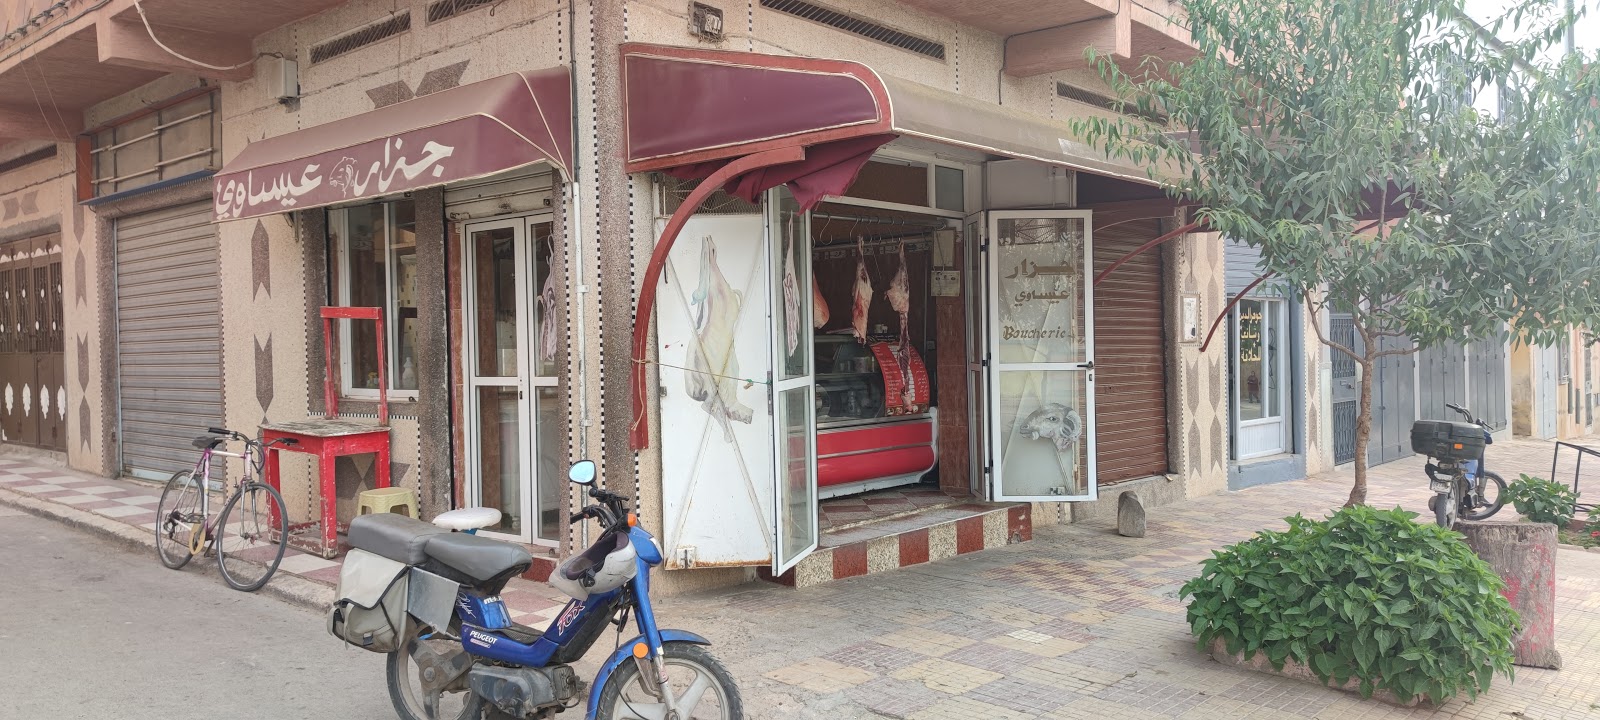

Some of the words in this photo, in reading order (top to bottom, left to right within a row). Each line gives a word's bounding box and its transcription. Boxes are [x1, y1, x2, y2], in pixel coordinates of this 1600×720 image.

[353, 137, 455, 197] جزار
[215, 163, 323, 220] عيساوي
[1004, 258, 1076, 279] جزار
[1014, 289, 1070, 307] عيساوي
[1002, 325, 1067, 341] Boucherie
[469, 630, 498, 645] PEUGEOT
